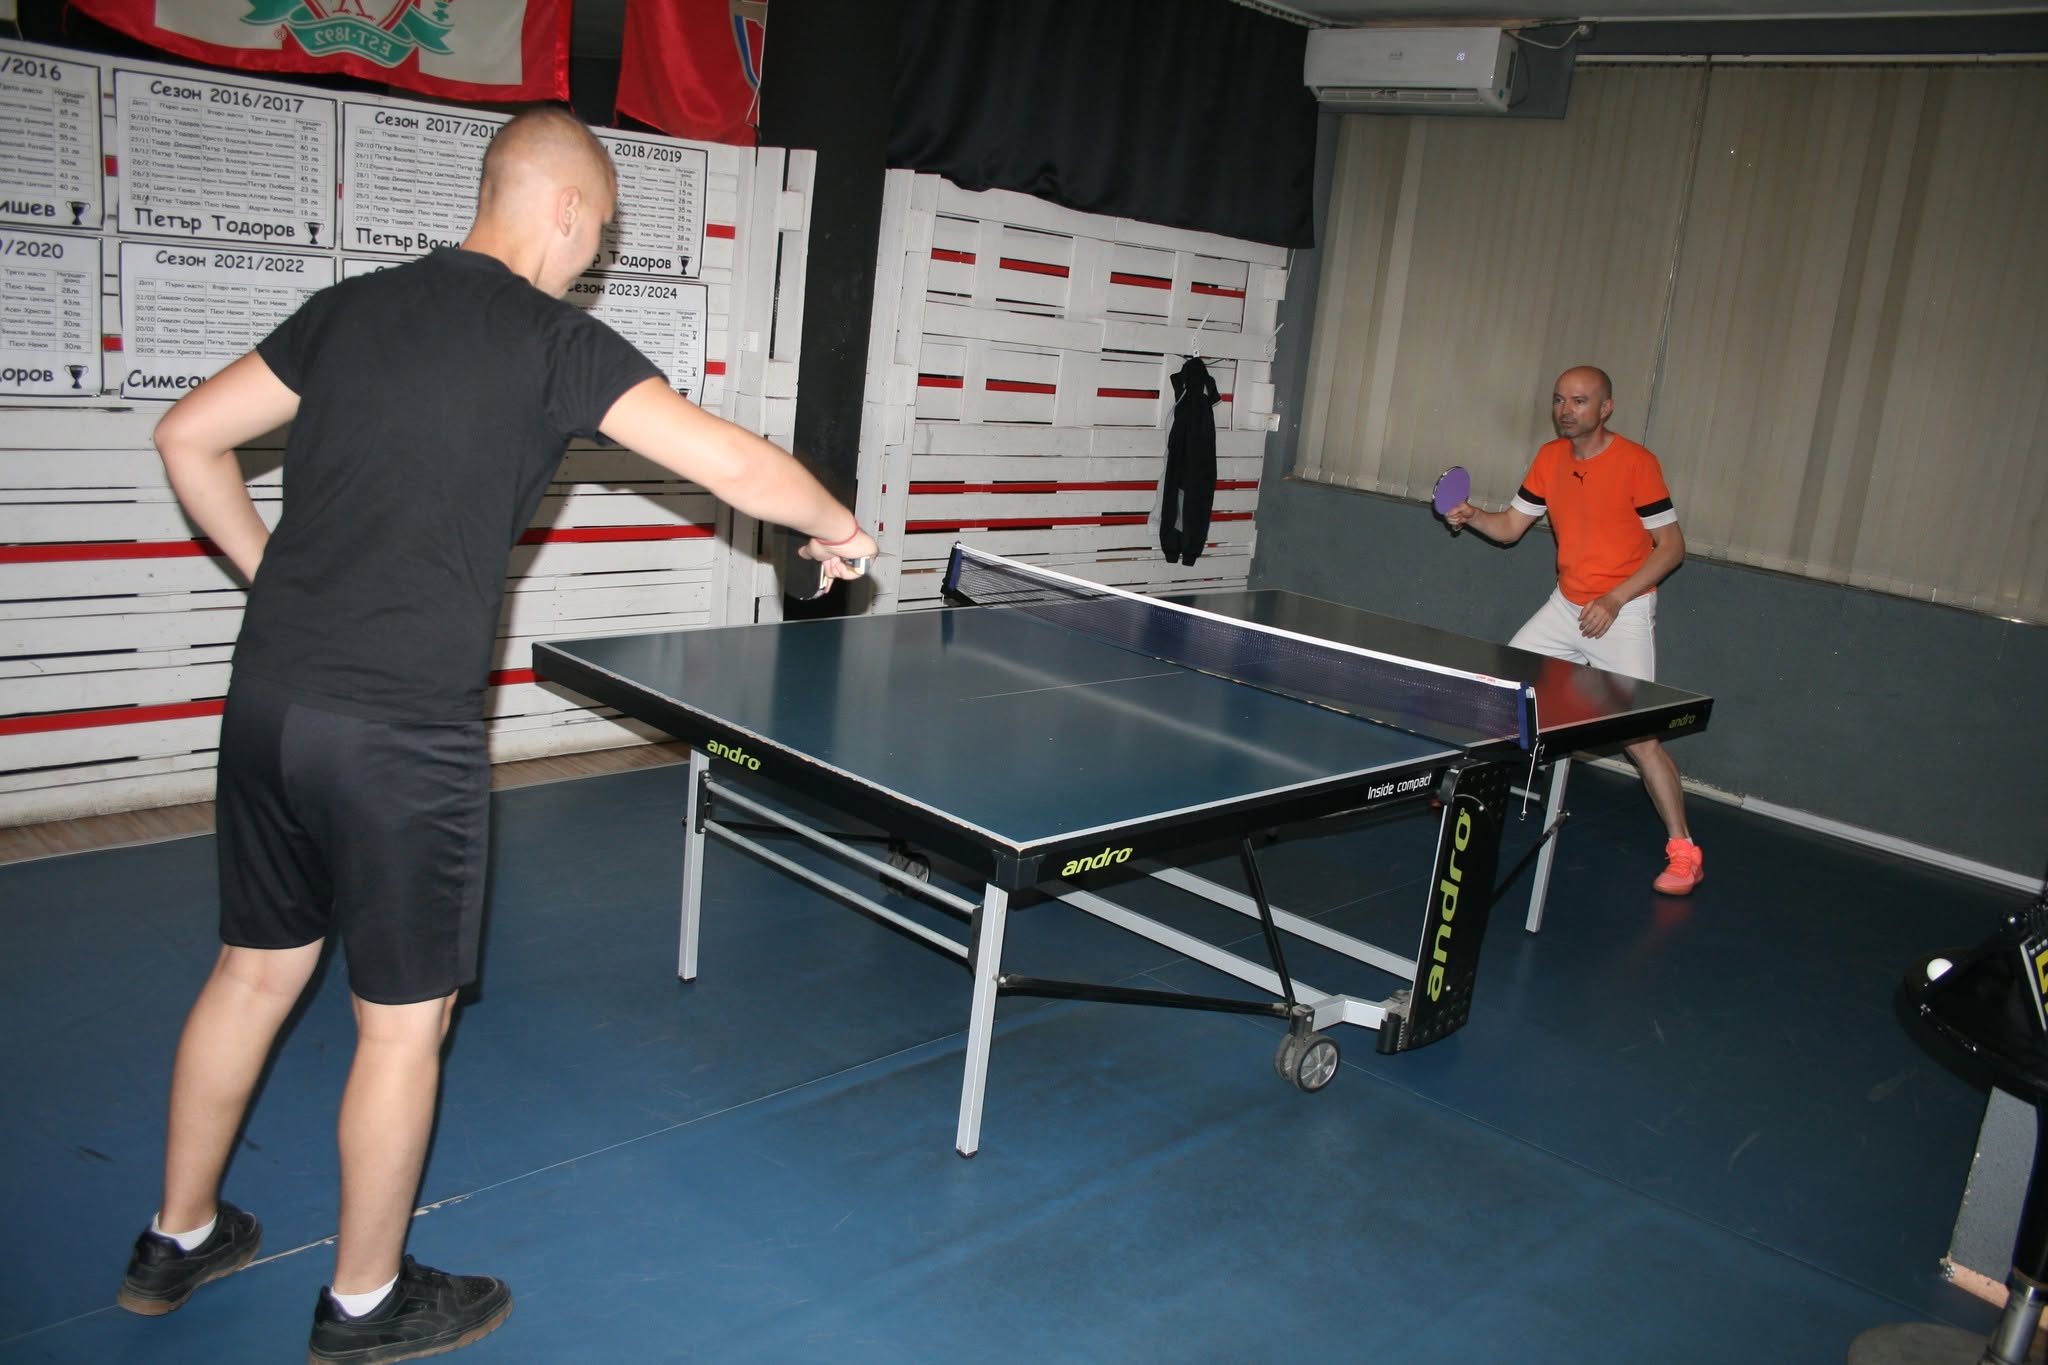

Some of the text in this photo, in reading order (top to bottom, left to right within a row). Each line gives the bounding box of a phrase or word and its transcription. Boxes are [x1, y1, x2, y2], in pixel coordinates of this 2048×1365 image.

[150, 80, 305, 113] Сезон 2016/2017
[375, 111, 501, 139] Сезон 2017/201
[614, 143, 682, 163] 2018/2019
[134, 207, 295, 240] Петър Тодоров
[0, 239, 64, 259] /2020
[356, 227, 461, 252] Петър Васи
[155, 250, 304, 273] Сезон 2021/2022
[608, 250, 672, 272] Тодоров
[568, 283, 678, 299] езон 2023/2024
[0, 367, 54, 387] оров
[127, 369, 207, 389] Симео
[706, 739, 761, 771] andro
[1367, 772, 1432, 800] Inside compact
[1061, 847, 1133, 876] andro
[1427, 807, 1472, 1003] andro
